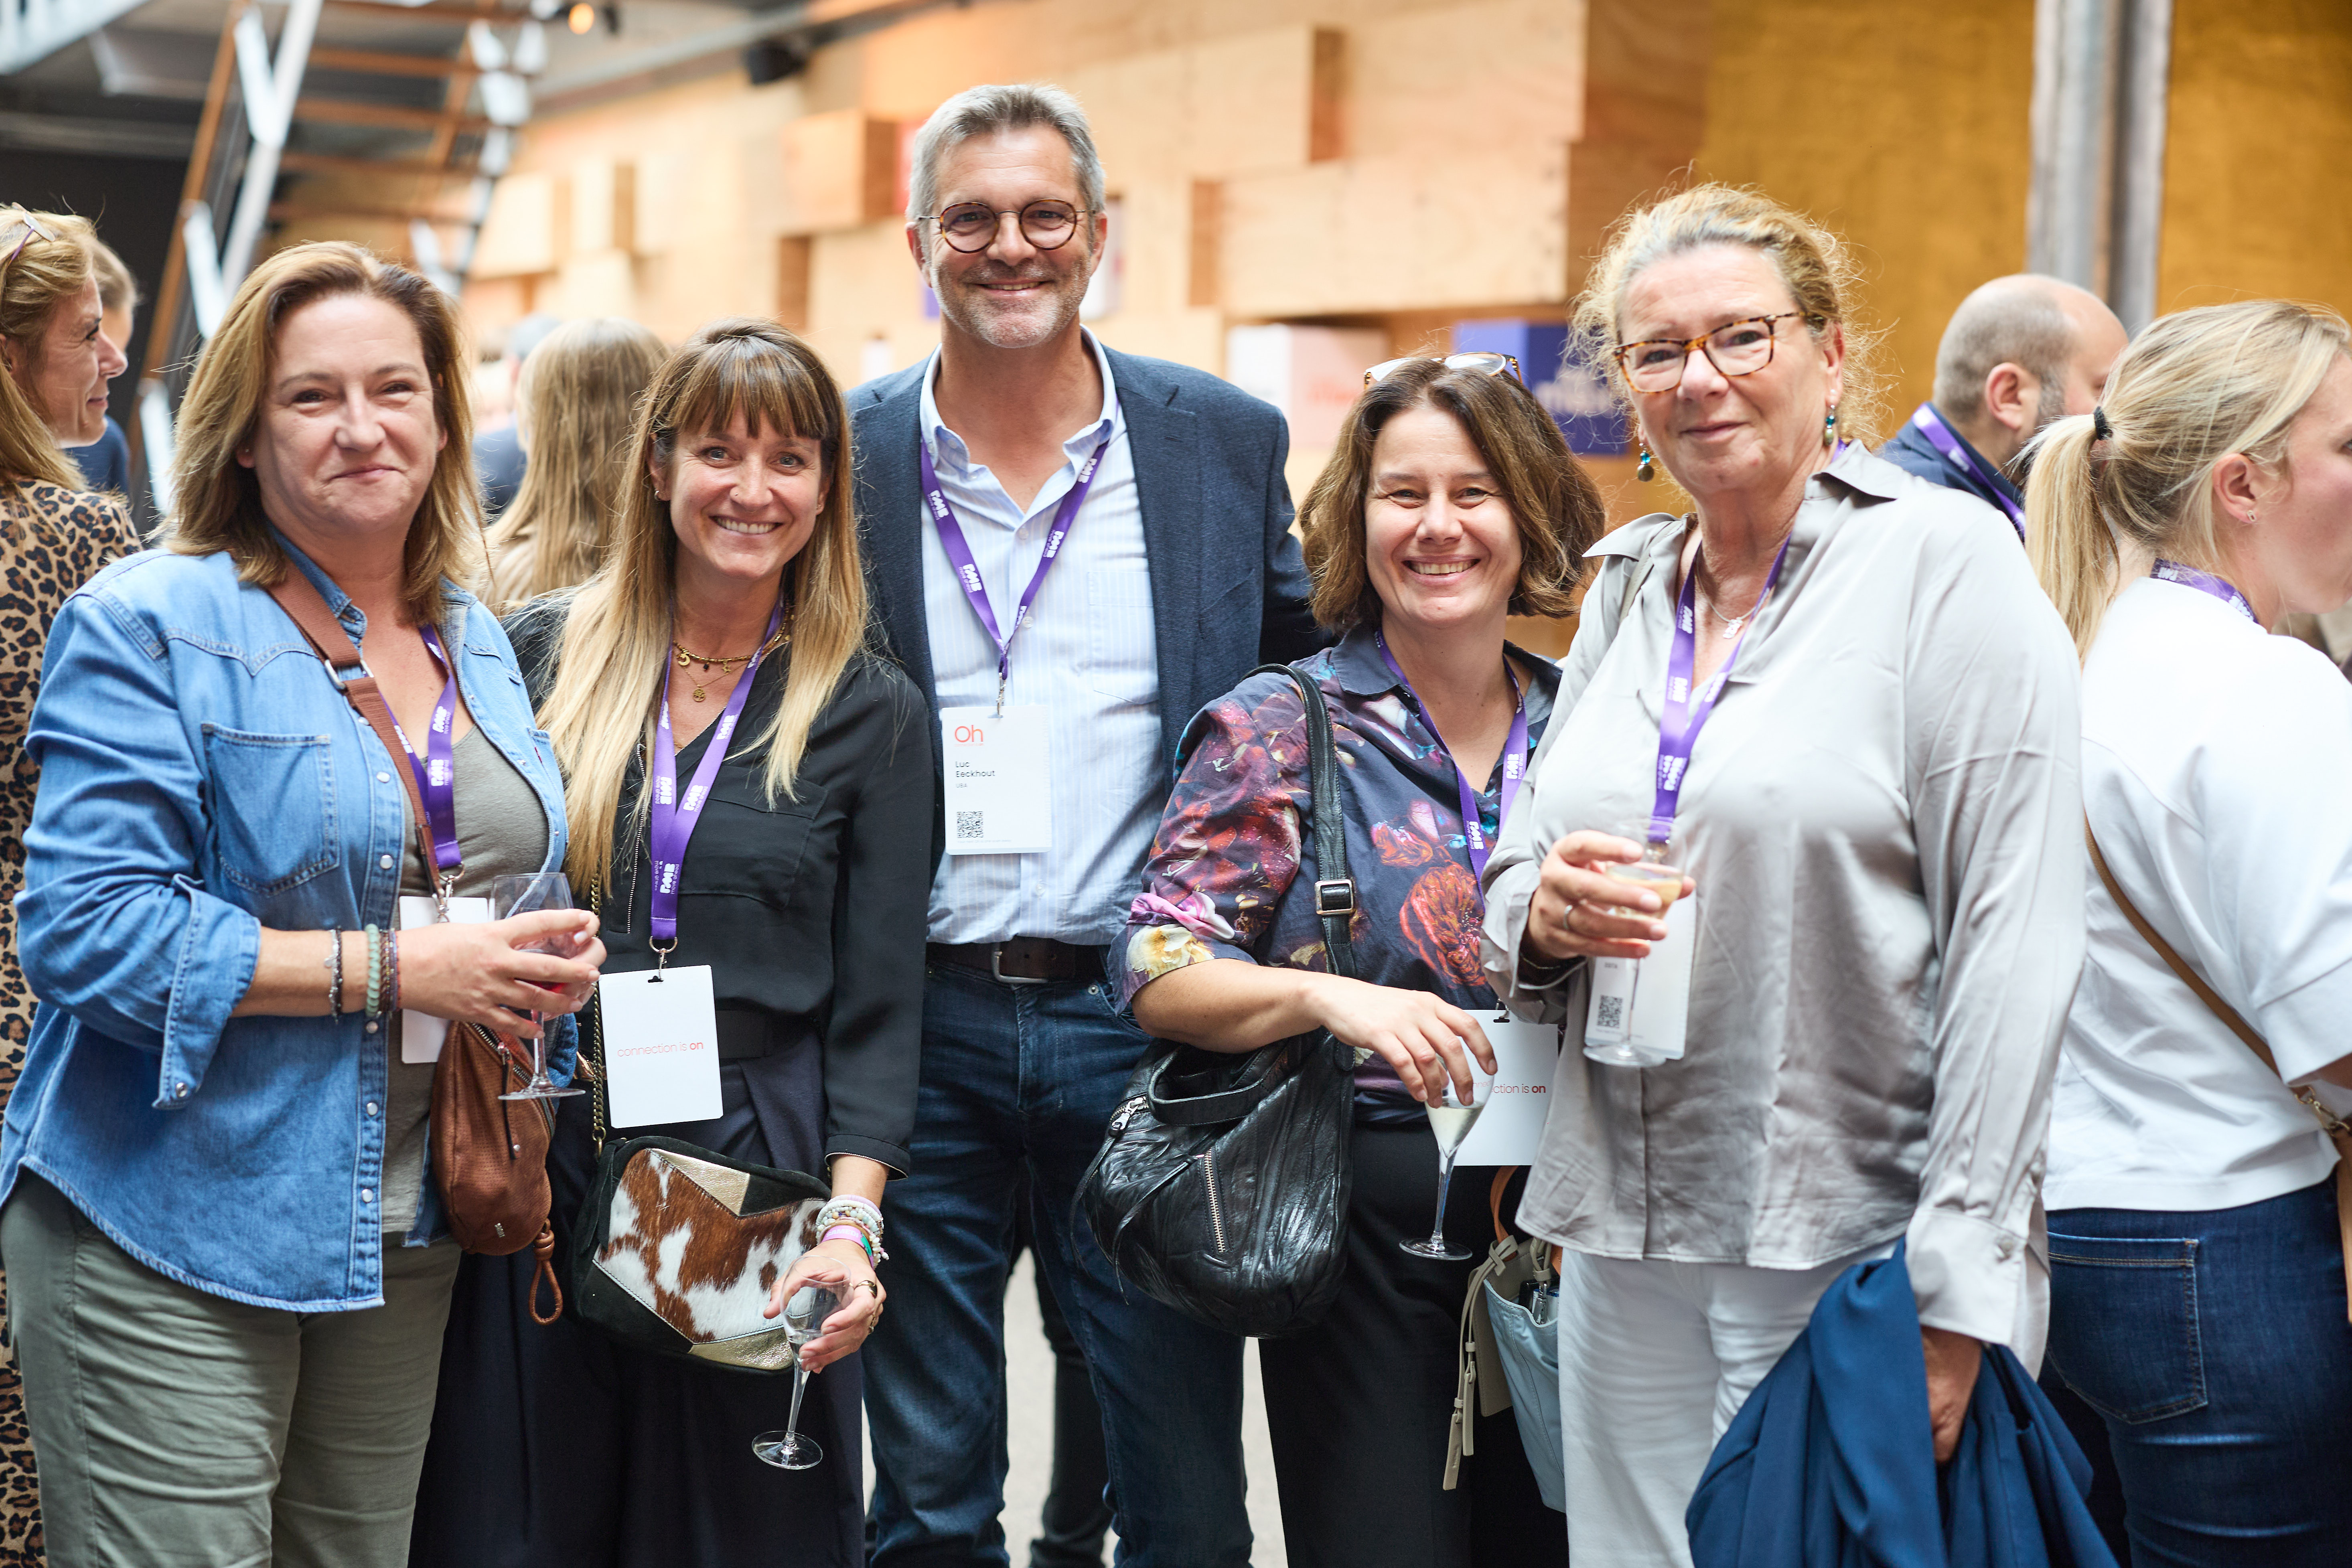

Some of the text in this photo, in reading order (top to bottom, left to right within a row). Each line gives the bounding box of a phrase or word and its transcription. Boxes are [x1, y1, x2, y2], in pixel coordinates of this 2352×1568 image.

[955, 725, 983, 743] Oh
[693, 786, 708, 812] move ahead
[617, 1041, 704, 1057] connection is on
[1522, 1084, 1529, 1093] is
[826, 1228, 859, 1238] SAMEDI
